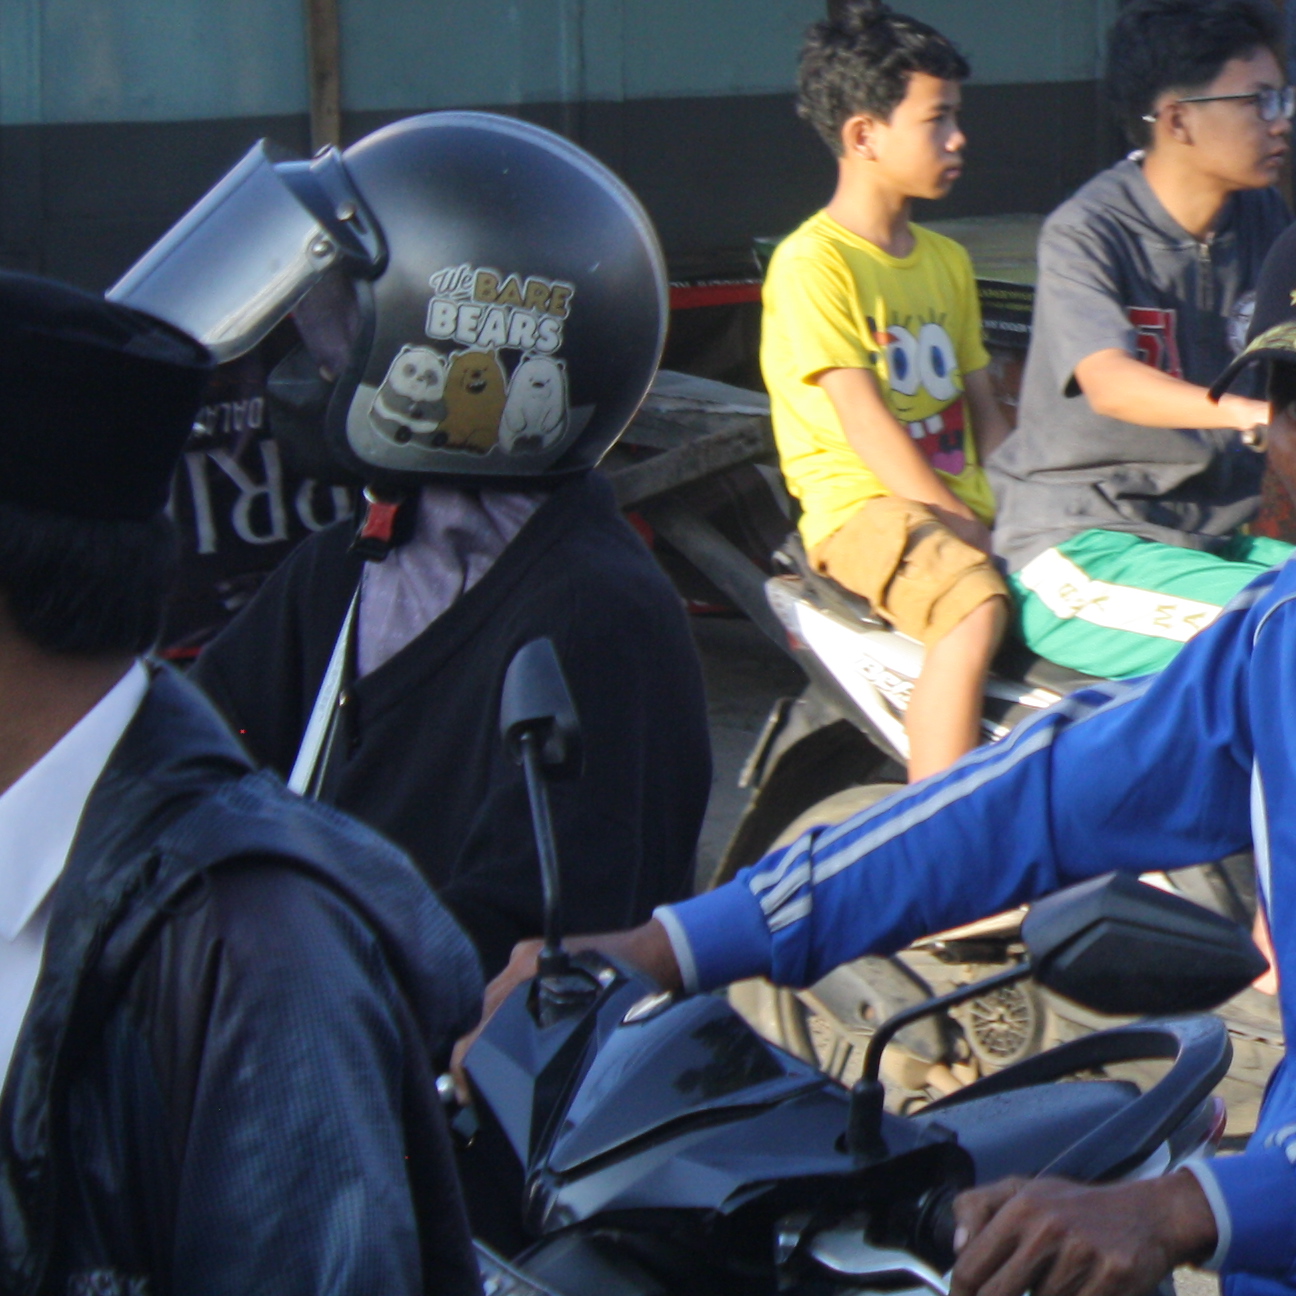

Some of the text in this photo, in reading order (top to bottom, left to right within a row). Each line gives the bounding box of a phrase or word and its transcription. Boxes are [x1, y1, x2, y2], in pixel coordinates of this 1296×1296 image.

[429, 263, 574, 318] We BARE
[426, 298, 562, 354] BEARS
